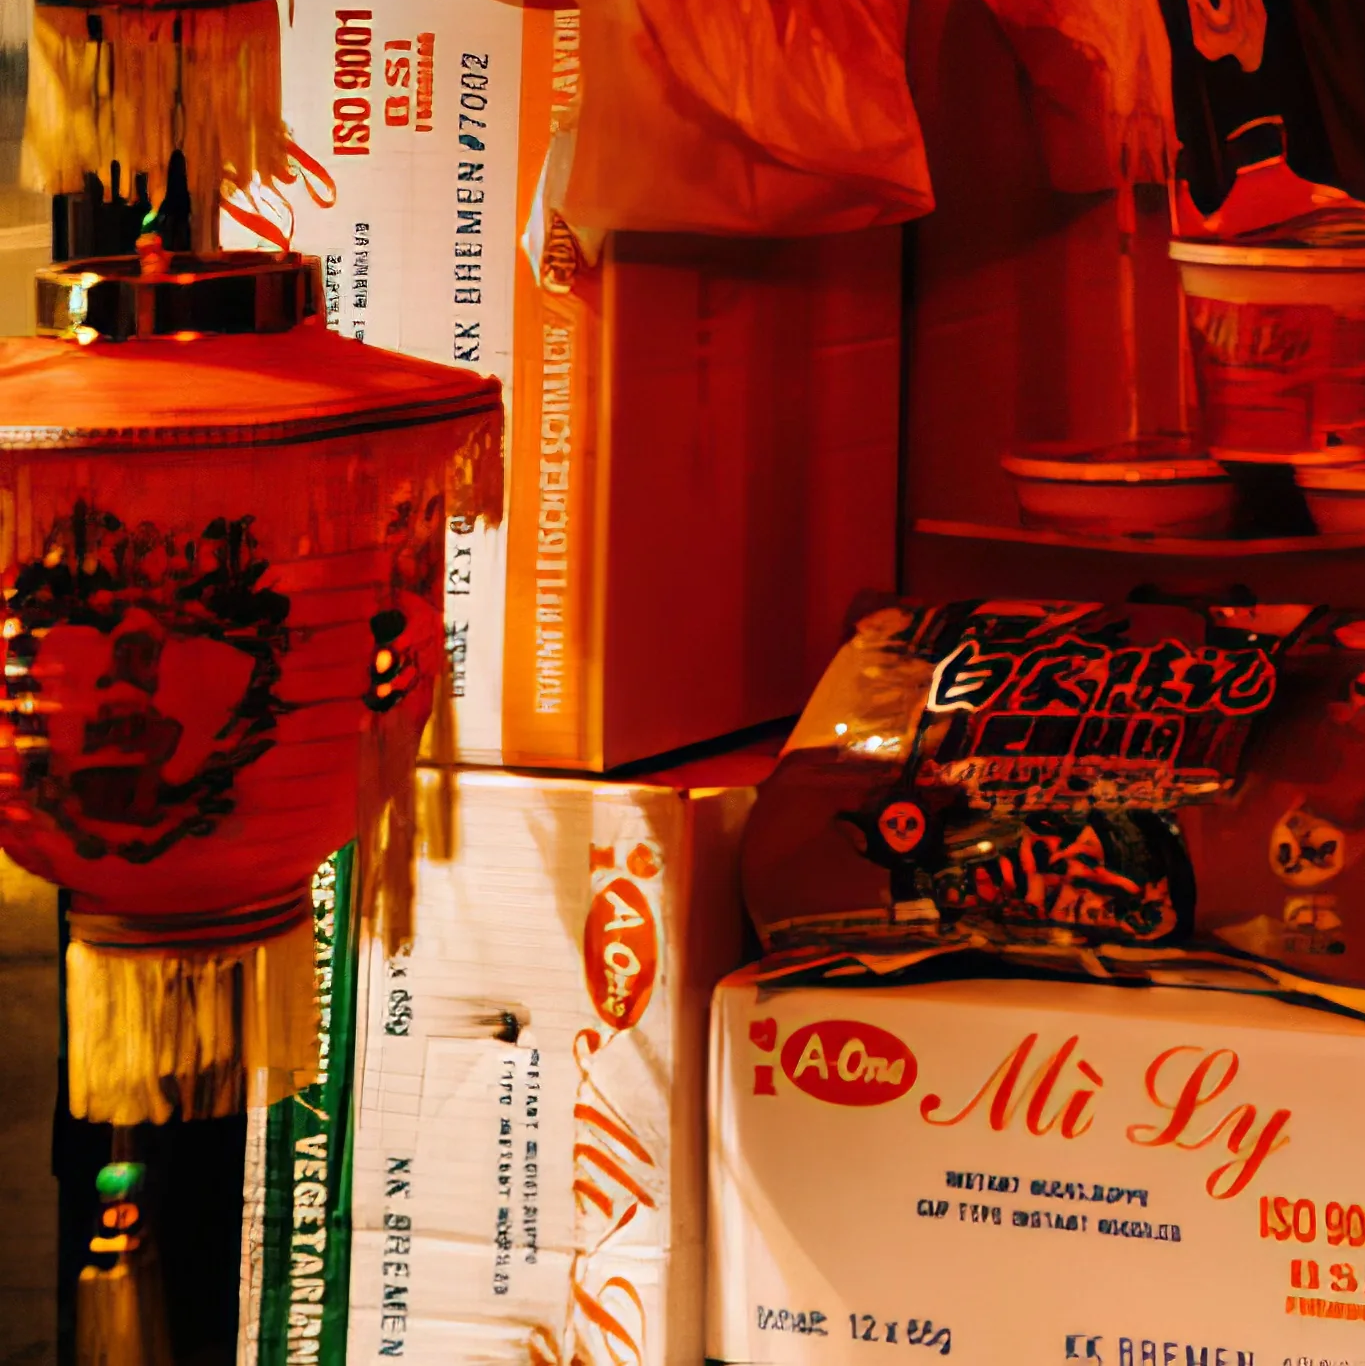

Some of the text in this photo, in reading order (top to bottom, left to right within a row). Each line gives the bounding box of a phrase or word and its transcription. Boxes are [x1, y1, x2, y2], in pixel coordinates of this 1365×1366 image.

[333, 10, 373, 155] ISO 9001
[921, 1032, 1293, 1200] Mì Ly
[1260, 1196, 1316, 1243] ISO
[849, 1312, 880, 1342] 12
